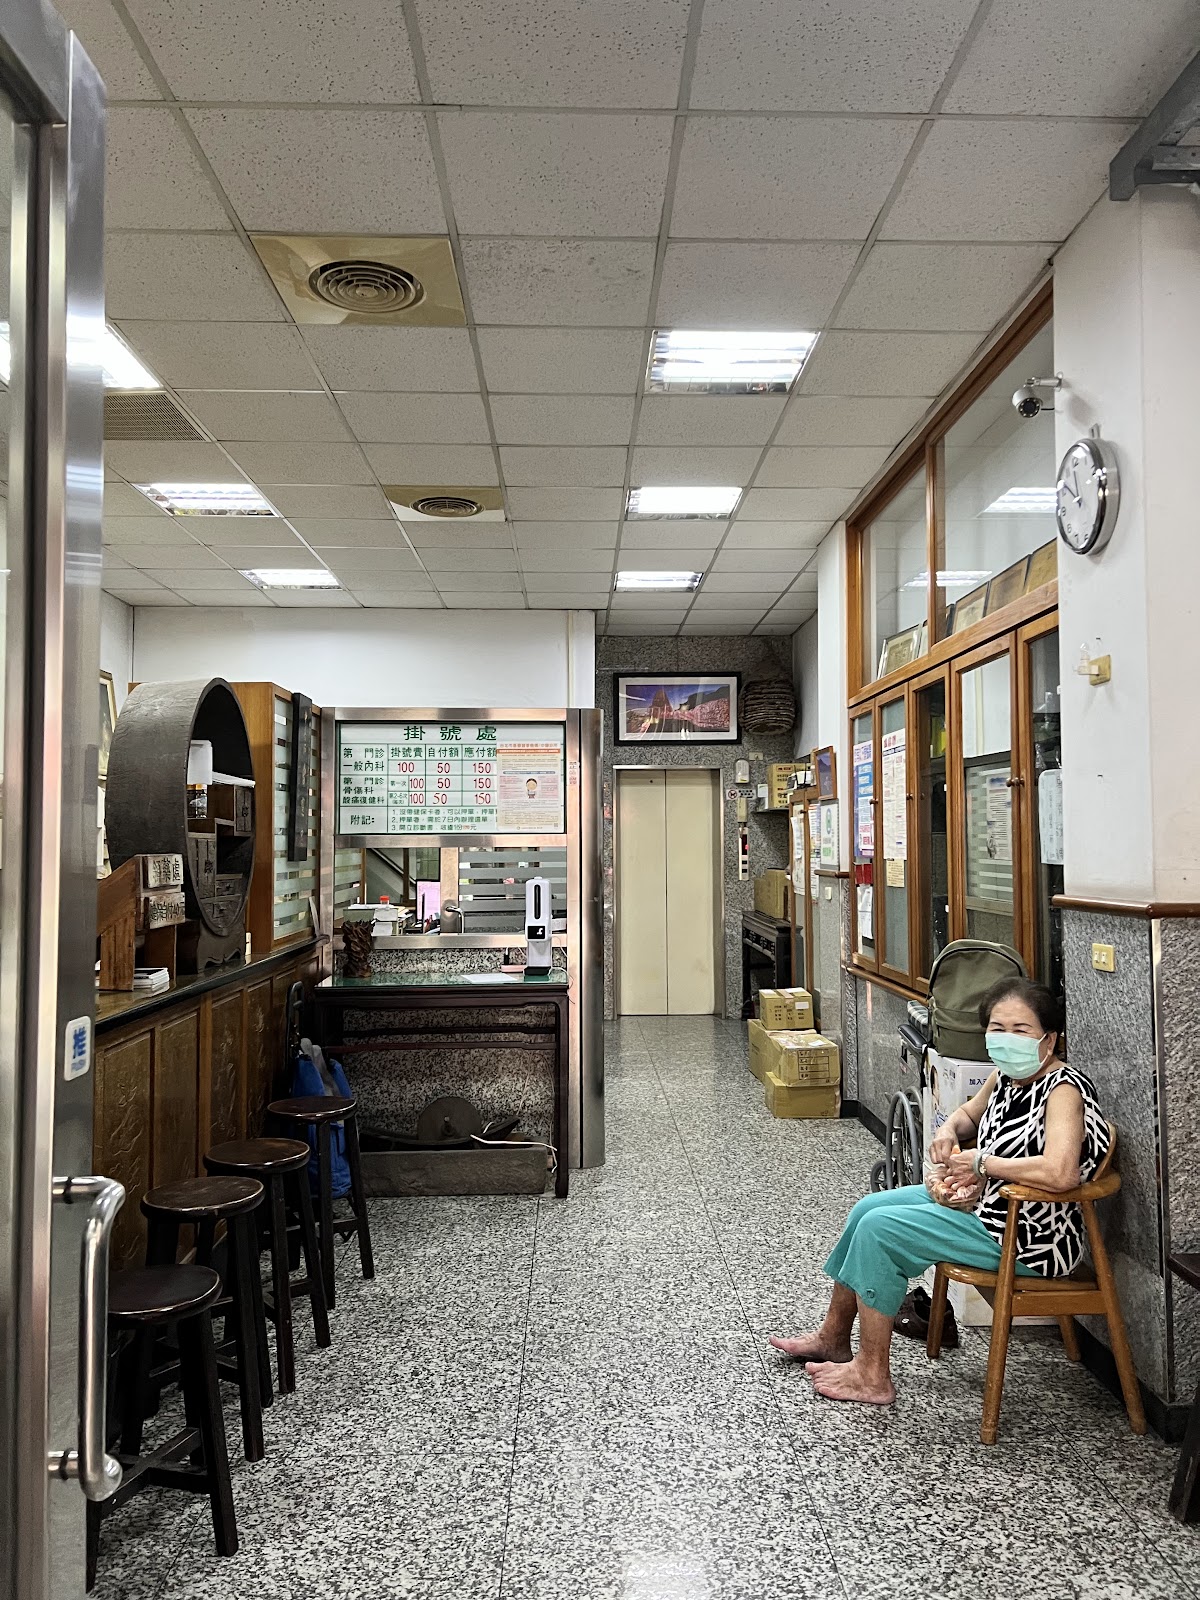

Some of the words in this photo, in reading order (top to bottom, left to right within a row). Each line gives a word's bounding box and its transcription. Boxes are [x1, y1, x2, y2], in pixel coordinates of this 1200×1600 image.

[403, 726, 497, 741] 掛號處
[343, 747, 353, 758] 第
[364, 747, 385, 758] 門診
[390, 746, 423, 758] 掛號費
[428, 747, 459, 758] 自付額
[464, 747, 497, 758] 應付額
[342, 760, 385, 771] 一般內科
[397, 762, 415, 773] 100
[437, 762, 451, 774] 50
[472, 762, 492, 774] 150
[364, 777, 385, 785] 門診
[409, 777, 425, 789] 100
[437, 777, 451, 789] 50
[473, 777, 492, 789] 150
[342, 786, 374, 795] 骨傷科
[409, 793, 425, 804] 100
[432, 792, 448, 805] 50
[474, 792, 491, 805] 150
[350, 814, 375, 825] 附記:
